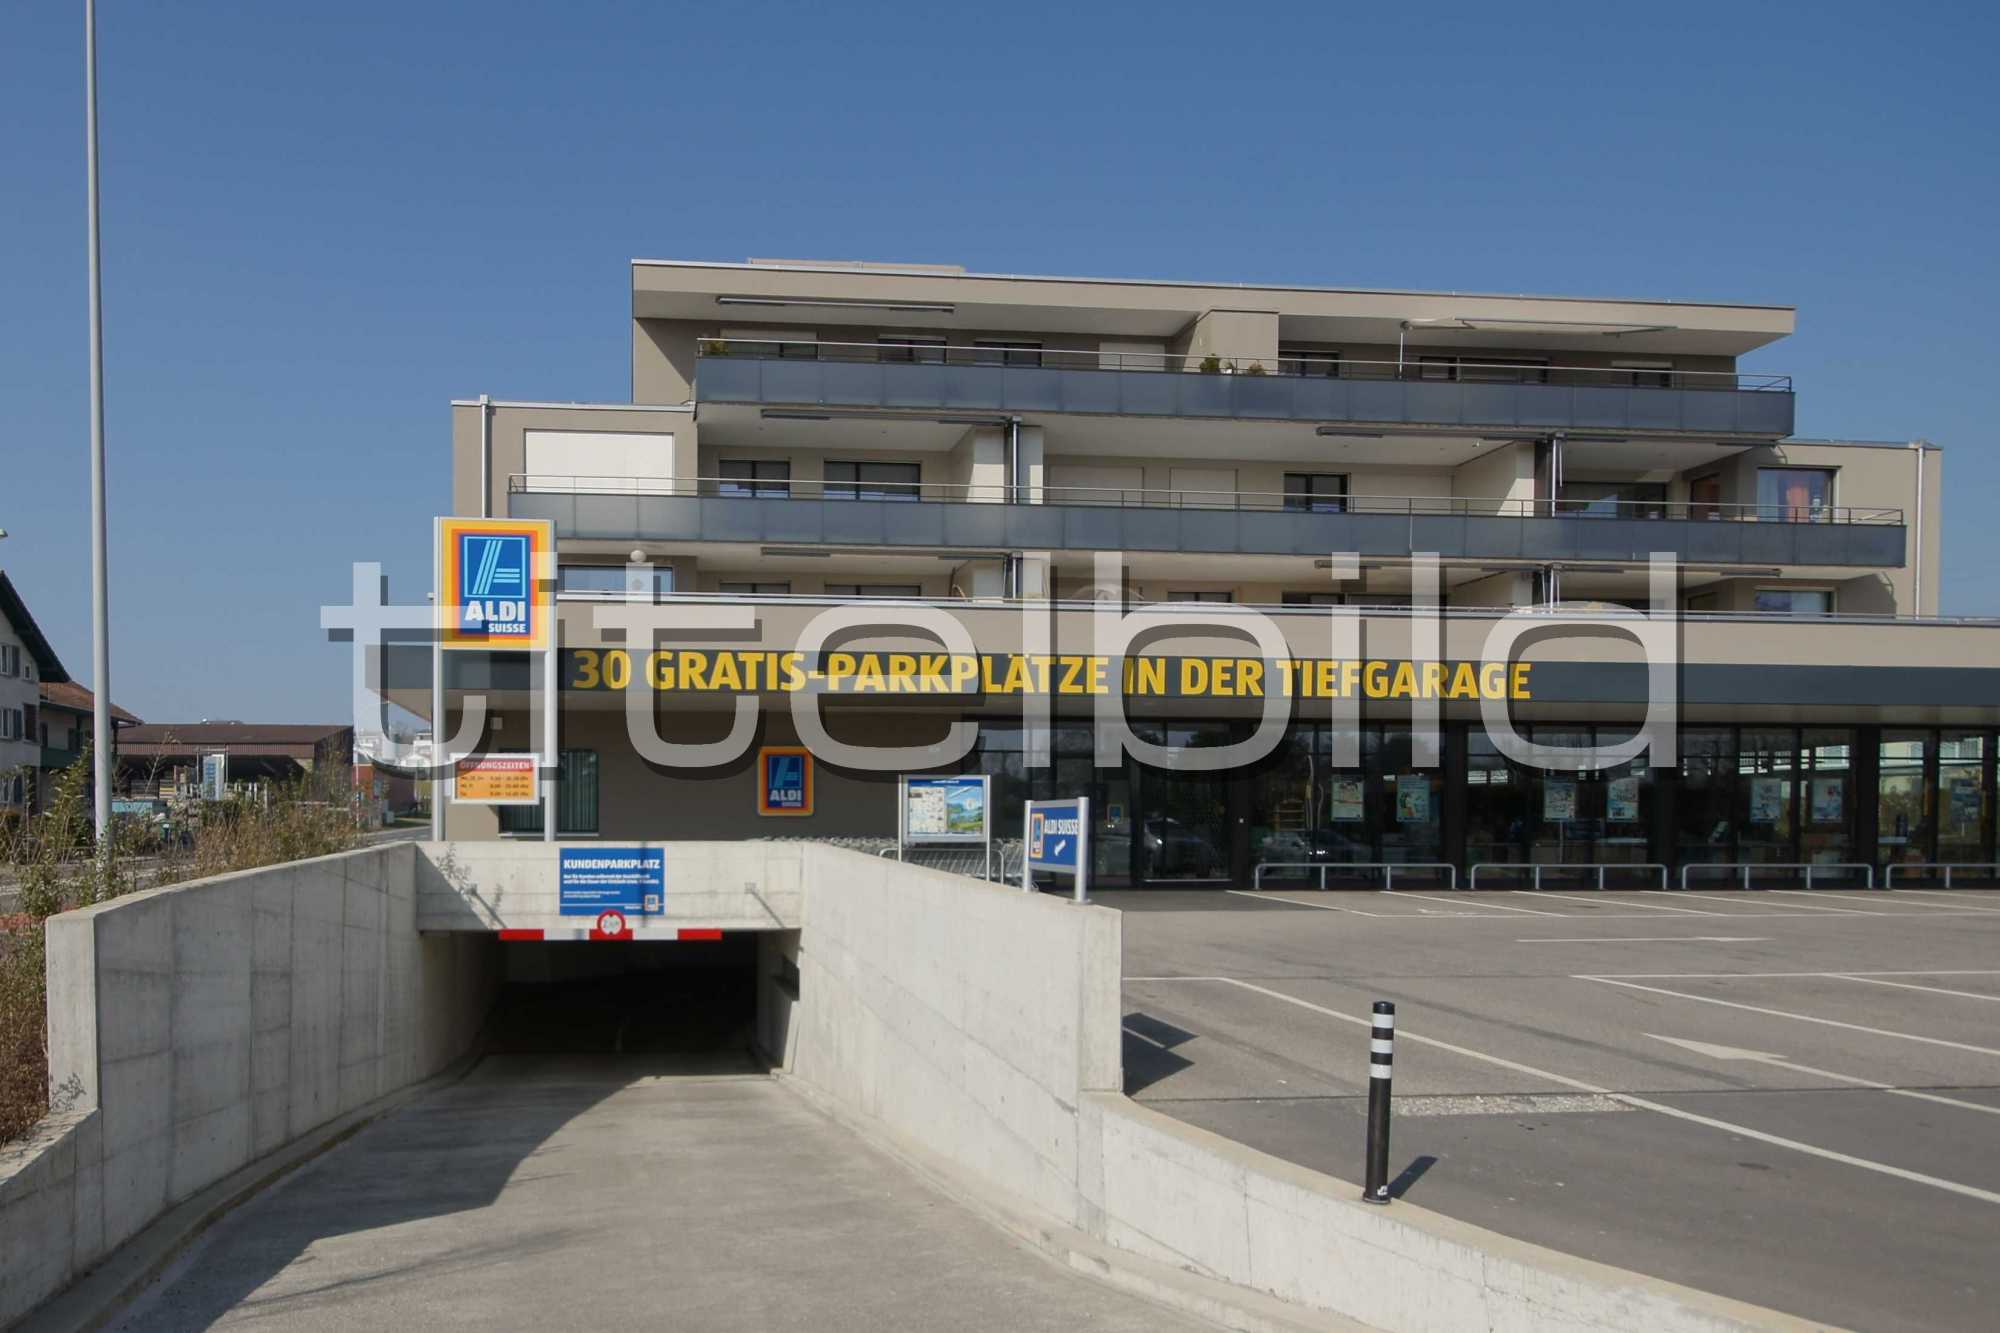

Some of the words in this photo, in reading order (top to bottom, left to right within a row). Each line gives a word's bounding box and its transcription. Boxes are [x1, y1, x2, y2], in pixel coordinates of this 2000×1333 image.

[464, 600, 526, 621] ALDI
[488, 623, 526, 633] SUISSE
[572, 650, 631, 691] 30
[645, 650, 1108, 694] GRATIS-PARKPLÄTZE
[1123, 657, 1166, 696] IN
[1180, 658, 1265, 697] DER
[1276, 659, 1532, 700] TIEFGARAGE
[769, 789, 802, 801] ALDI
[563, 859, 660, 869] KUNDENPARKPLATZ
